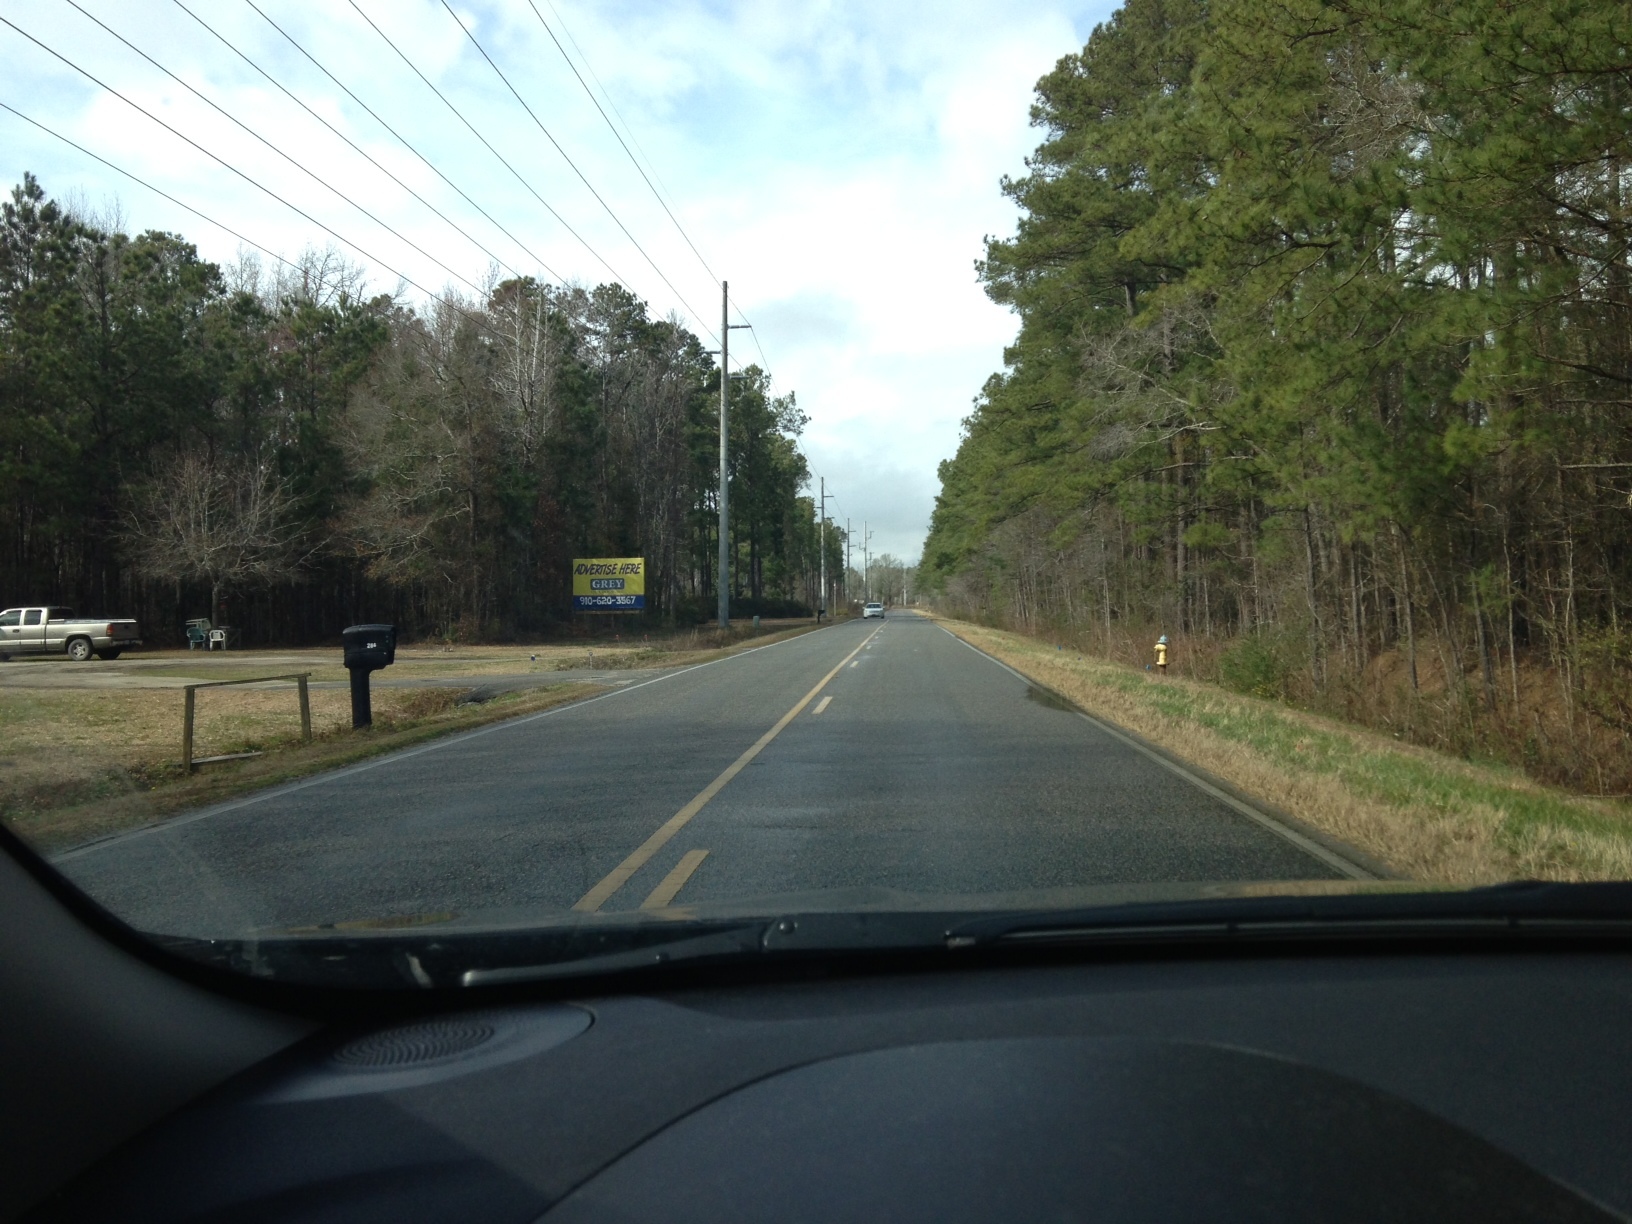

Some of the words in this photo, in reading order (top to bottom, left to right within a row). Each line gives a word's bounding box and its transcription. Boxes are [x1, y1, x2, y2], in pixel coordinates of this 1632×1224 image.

[574, 563, 618, 575] ADVERTISE
[619, 563, 641, 575] HERE
[592, 579, 623, 588] GREY
[579, 596, 636, 605] 910-620-3567
